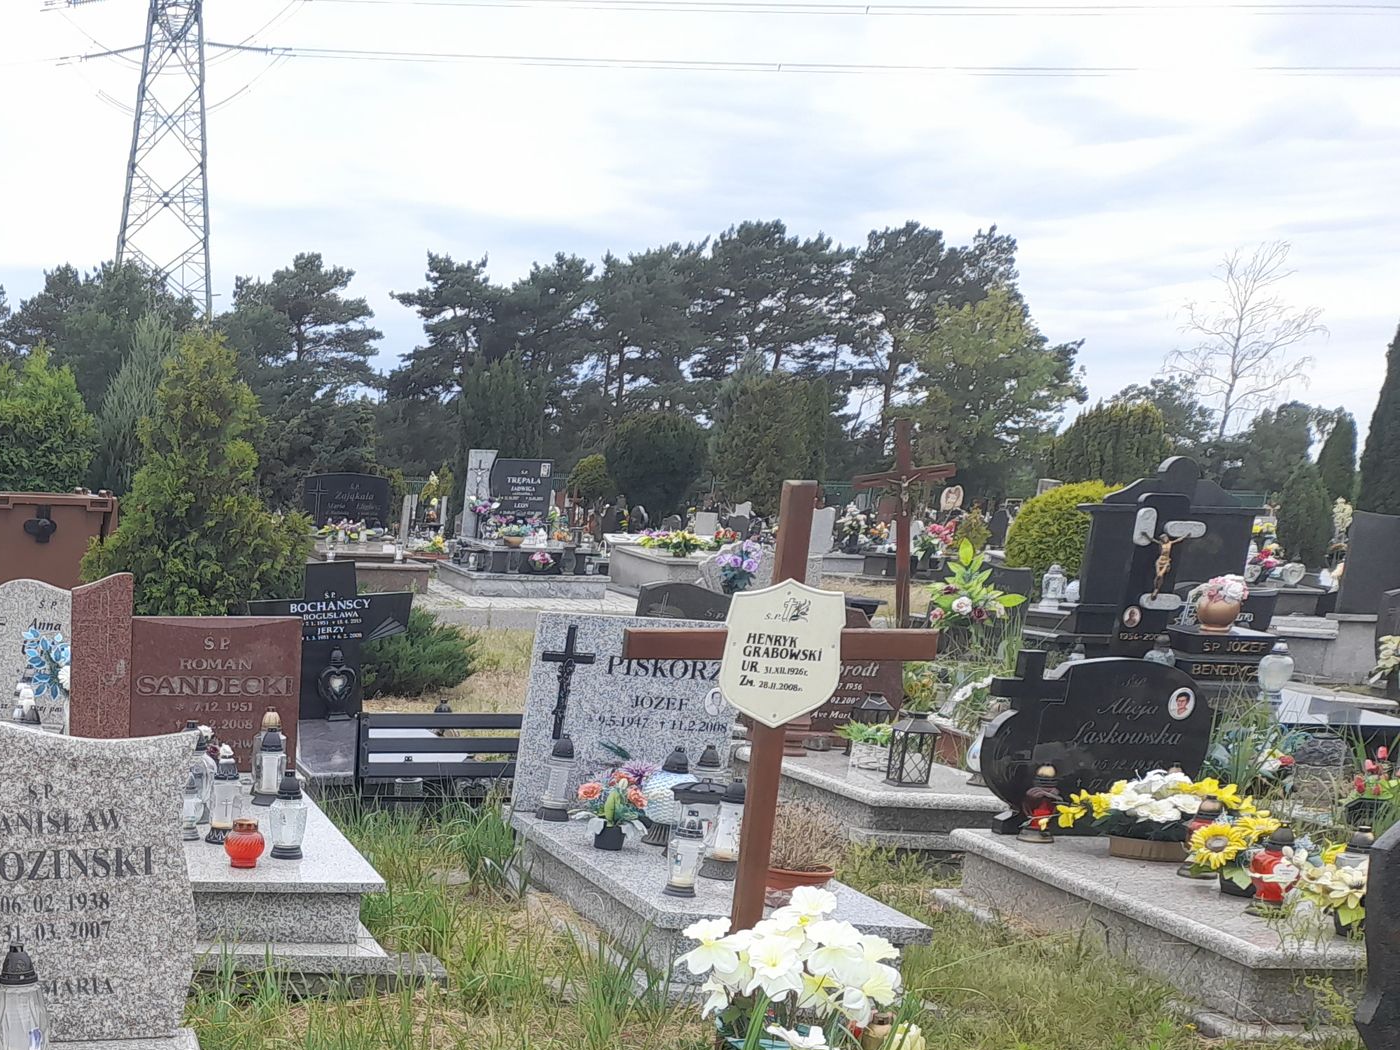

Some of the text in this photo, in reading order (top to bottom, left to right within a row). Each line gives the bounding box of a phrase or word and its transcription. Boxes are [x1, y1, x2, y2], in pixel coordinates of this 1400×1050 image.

[290, 596, 371, 613] BOCHAŃSCY
[29, 617, 62, 631] Anna
[317, 626, 345, 635] JERZY
[746, 632, 799, 648] HENRYK
[742, 645, 823, 662] GRABOWSKI
[179, 658, 253, 671] ROMAN
[136, 675, 295, 697] SANDECKI
[632, 692, 690, 712] JÓZEF
[1097, 698, 1160, 720] Alicja
[810, 710, 851, 719] Ave Mari
[69, 891, 111, 912] 1938
[70, 919, 113, 939] 2007
